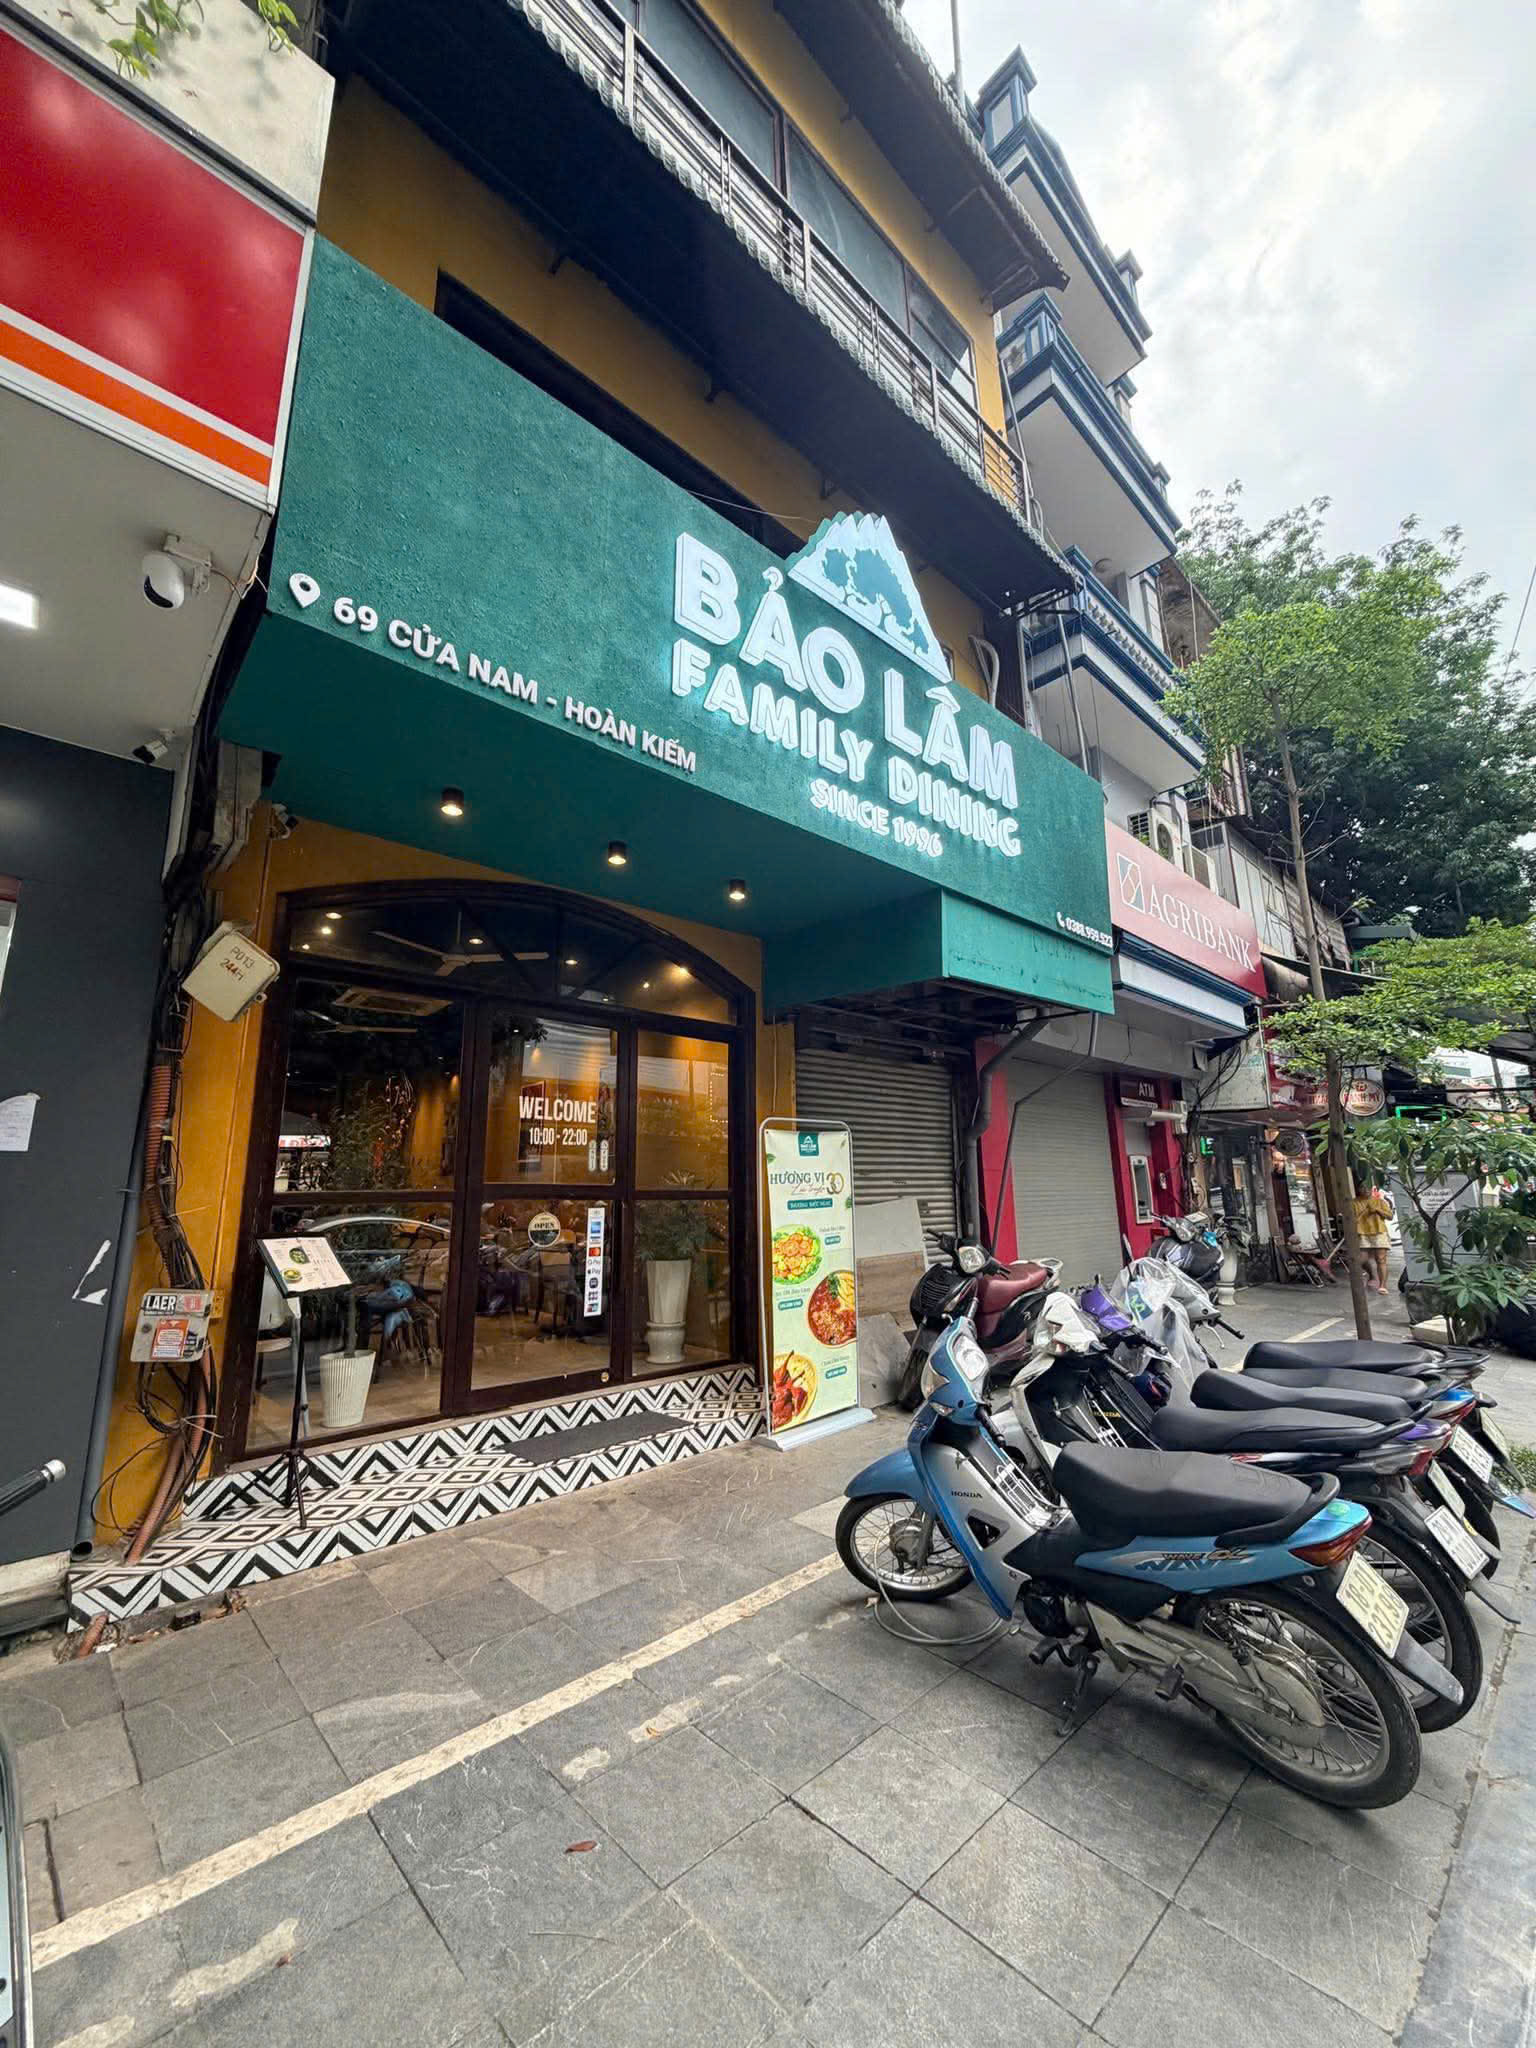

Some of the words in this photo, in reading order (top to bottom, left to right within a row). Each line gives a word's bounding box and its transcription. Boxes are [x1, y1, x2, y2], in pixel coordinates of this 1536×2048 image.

[333, 597, 378, 632] 69
[388, 624, 460, 672] CỬA
[468, 653, 538, 705] NAM
[546, 696, 557, 708] -
[564, 696, 636, 746] HOÀN
[642, 730, 696, 773] KIẾM
[674, 531, 865, 714] BẢO
[884, 668, 1018, 809] LÂM
[672, 638, 874, 783] FAMILY
[889, 757, 1021, 857] DINING
[809, 778, 889, 837] SINCE
[892, 816, 943, 858] 1996
[1149, 884, 1257, 973] AGRIBANK
[519, 1096, 597, 1124] WELCOME
[1139, 1081, 1155, 1098] ATM
[529, 1128, 555, 1145] 10:00
[562, 1128, 588, 1146] 22:00
[814, 1172, 825, 1186] VỊ
[826, 1172, 845, 1194] 30
[951, 1490, 983, 1499] HONDA
